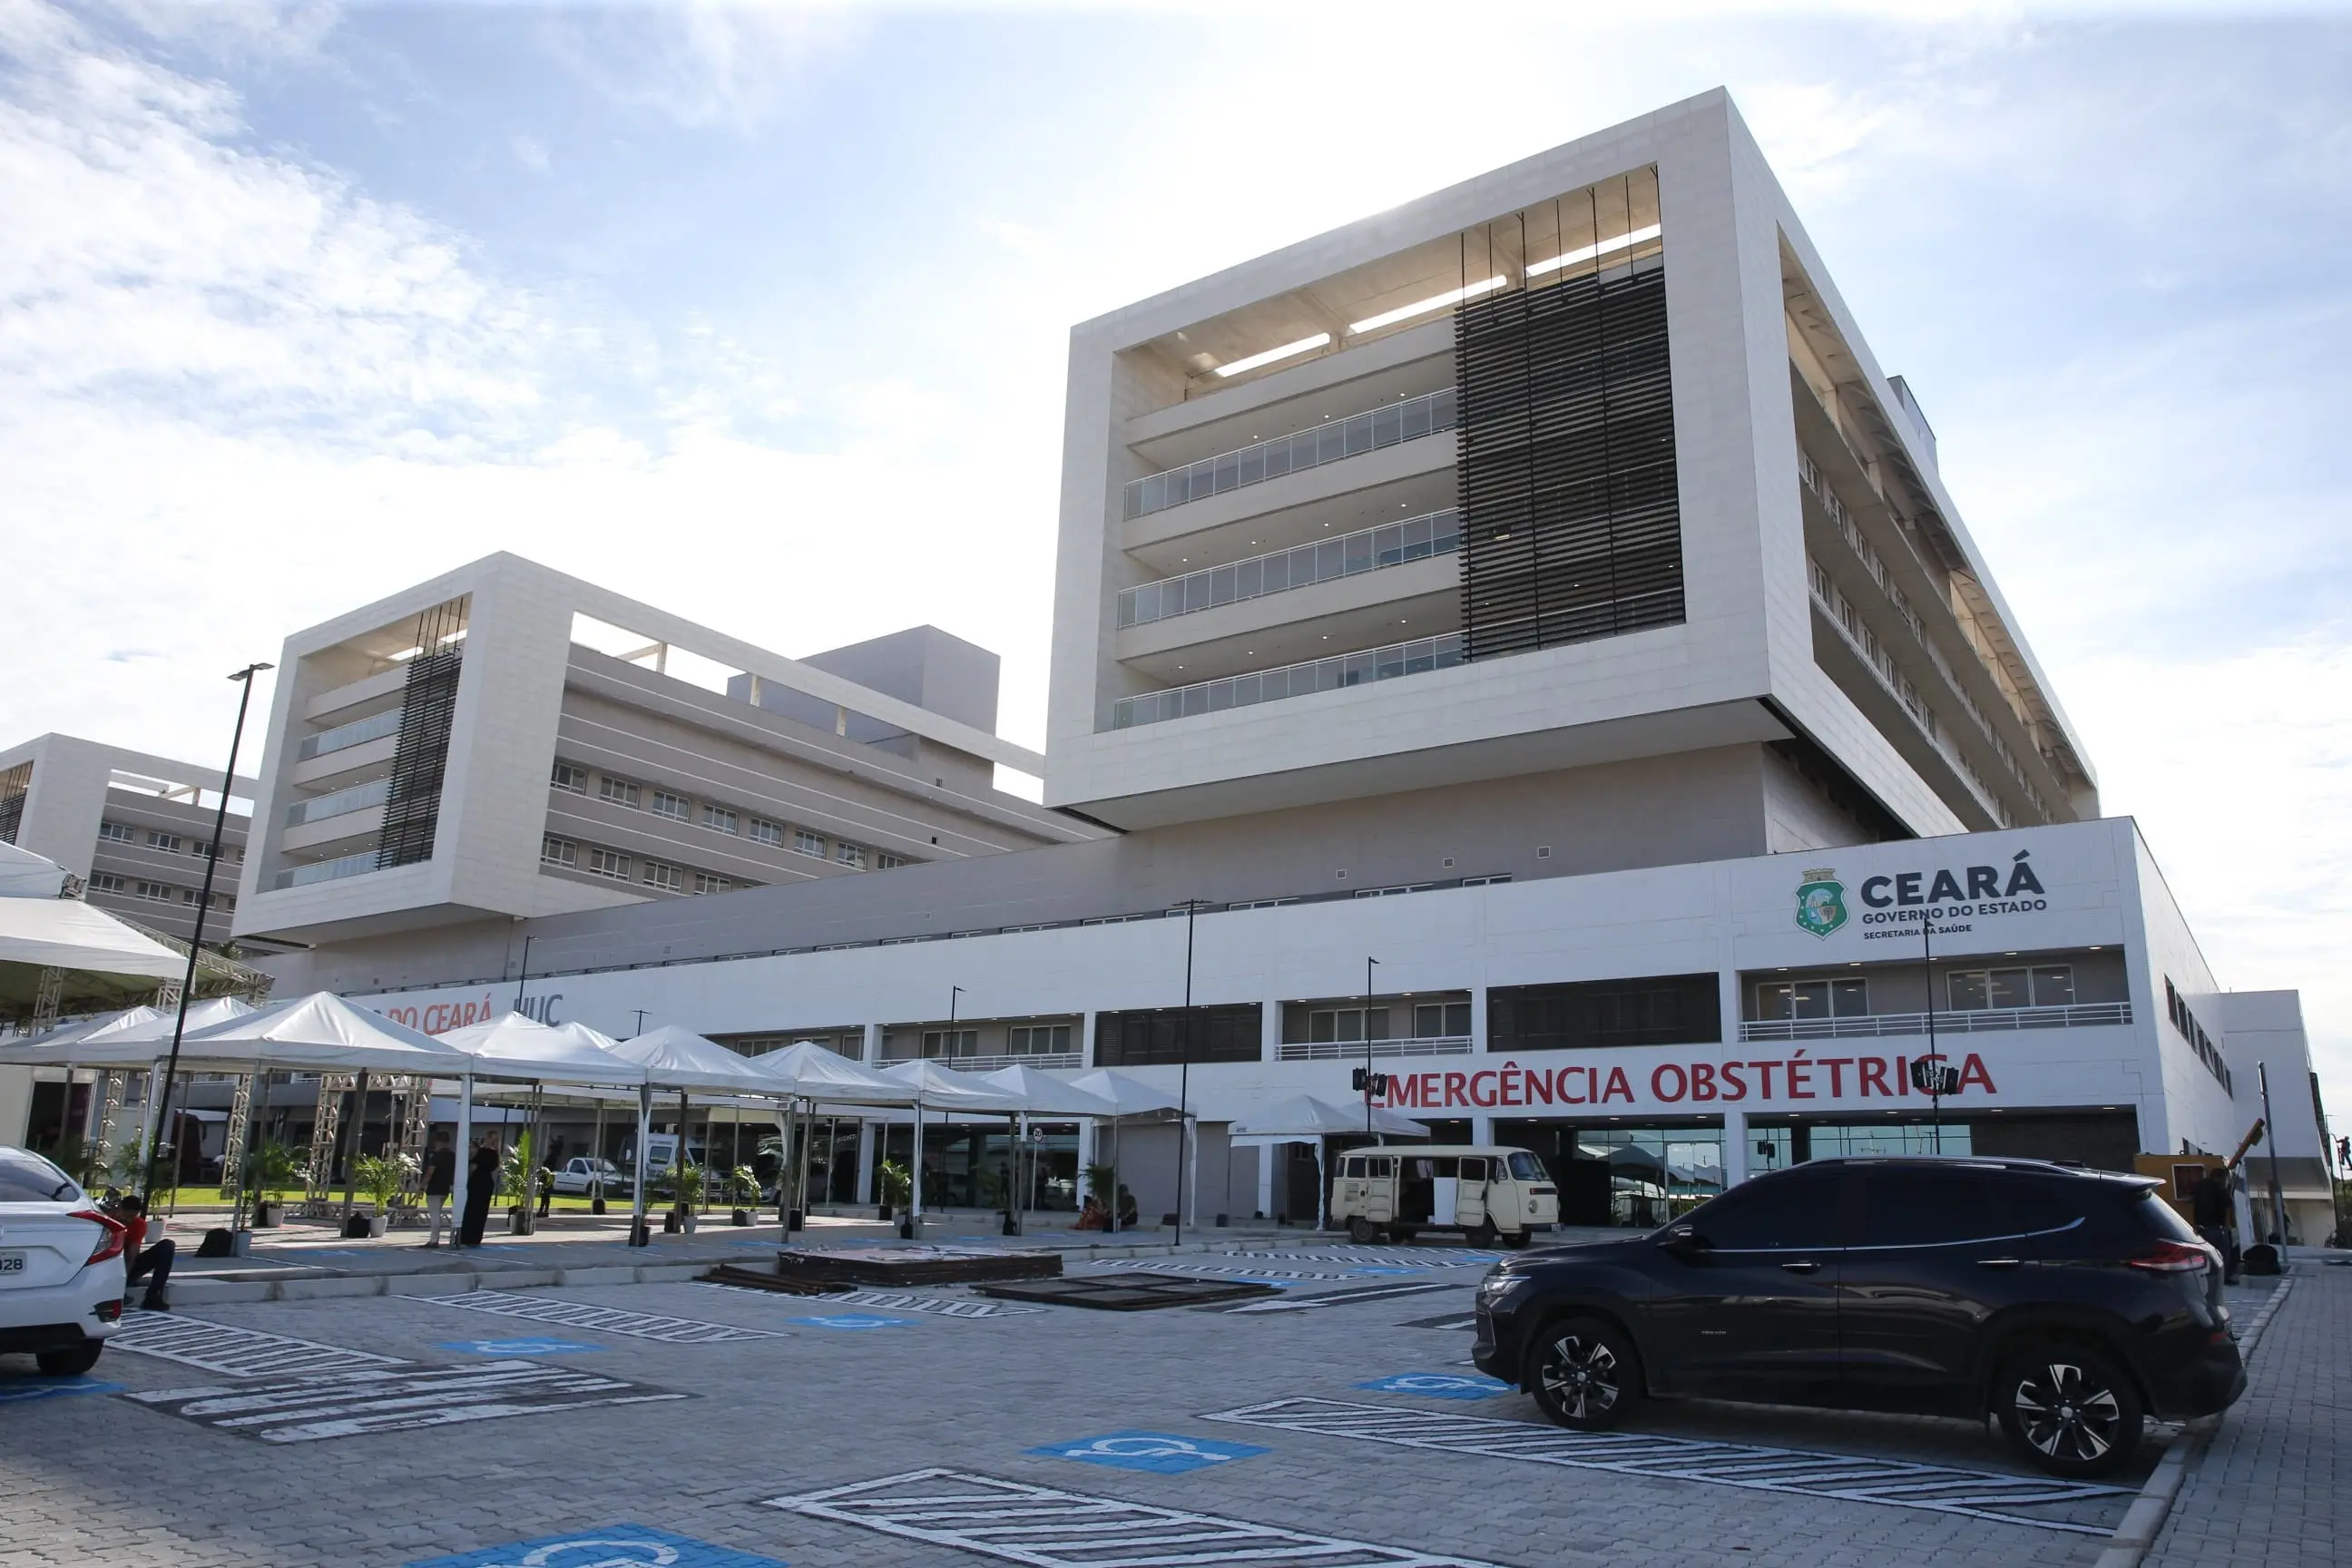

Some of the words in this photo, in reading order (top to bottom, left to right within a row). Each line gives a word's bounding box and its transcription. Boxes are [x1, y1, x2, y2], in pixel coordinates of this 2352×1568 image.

[1860, 848, 2045, 908] CEARÁ
[1862, 907, 1944, 925] GOVERNO
[1948, 905, 1974, 917] DO
[1978, 899, 2047, 916] ESTADO
[1864, 928, 1921, 940] SECRETARIA
[1938, 924, 1973, 935] SAÚDE
[423, 992, 493, 1036] CEARÁ
[0, 1259, 24, 1271] 28
